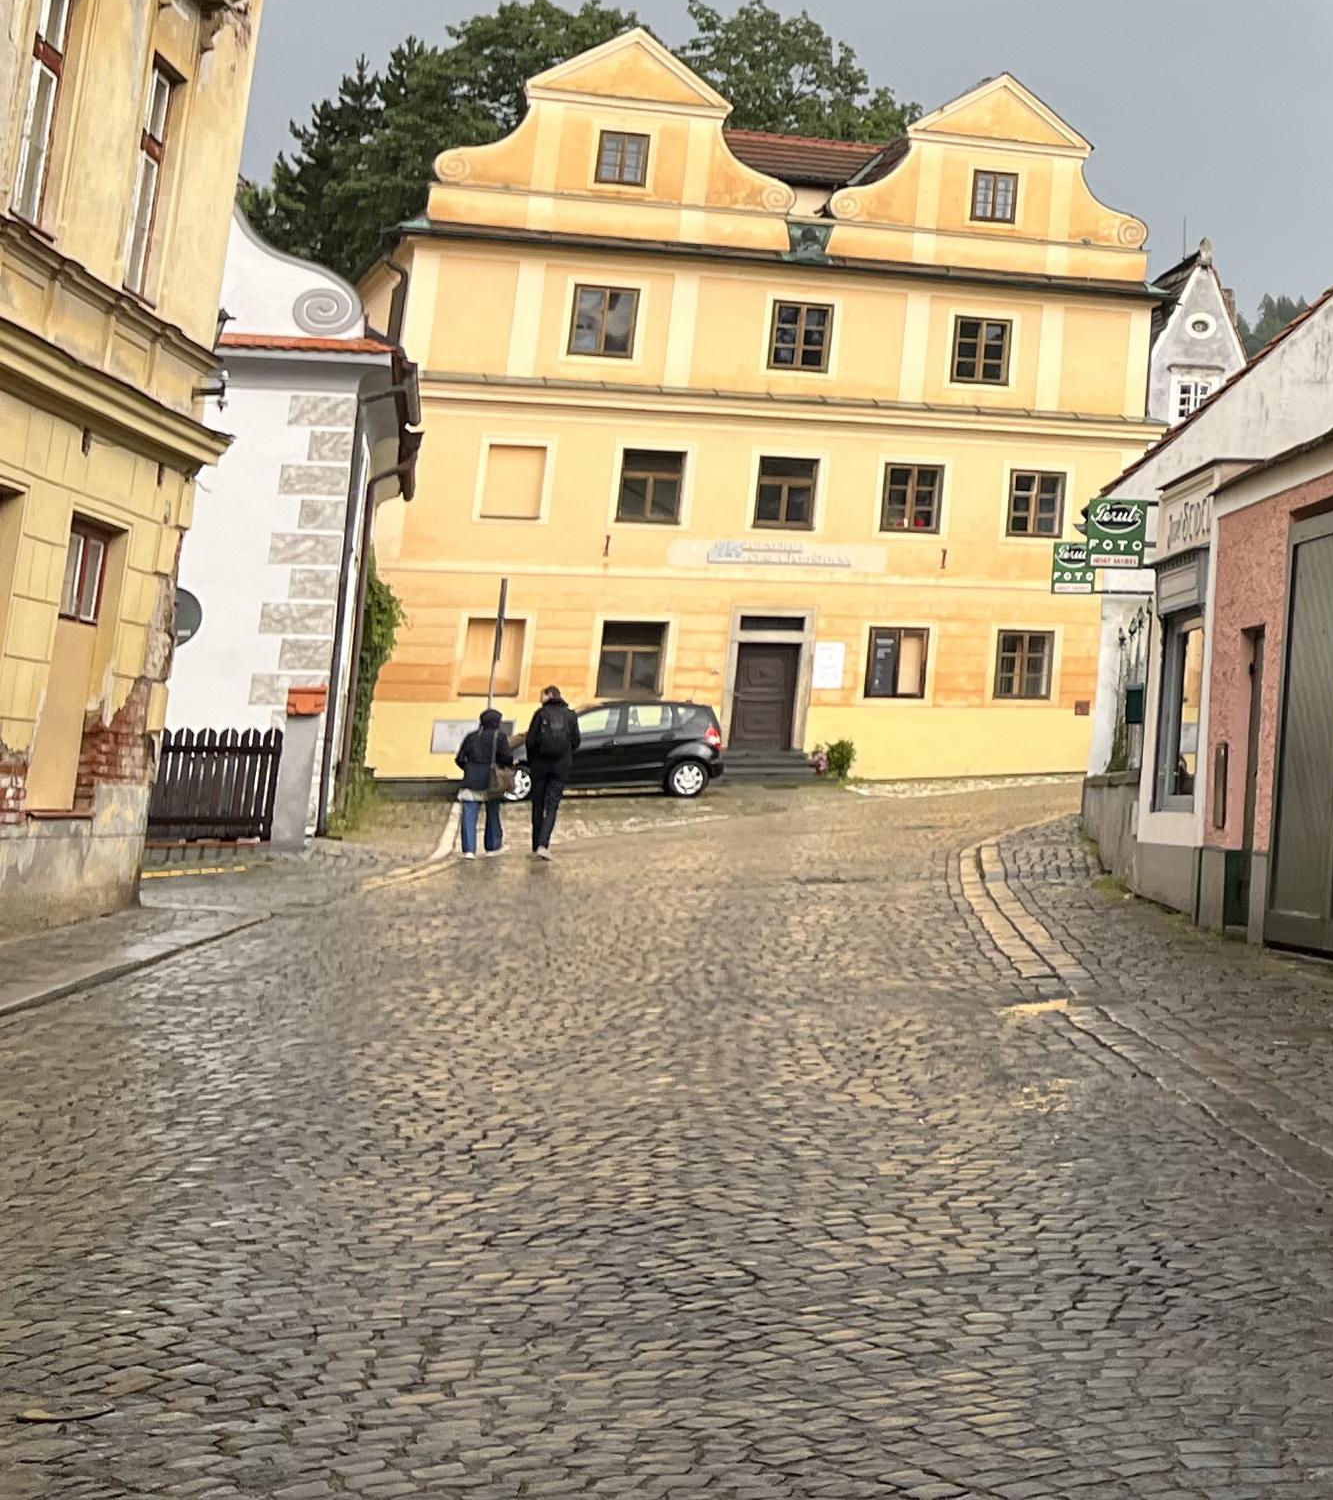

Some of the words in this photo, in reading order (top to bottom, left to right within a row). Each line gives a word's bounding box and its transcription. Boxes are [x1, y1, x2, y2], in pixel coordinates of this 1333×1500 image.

[1091, 501, 1144, 524] Perutz
[1055, 544, 1086, 559] Peru
[1089, 539, 1142, 551] FOTO
[1054, 571, 1093, 581] FOTO
